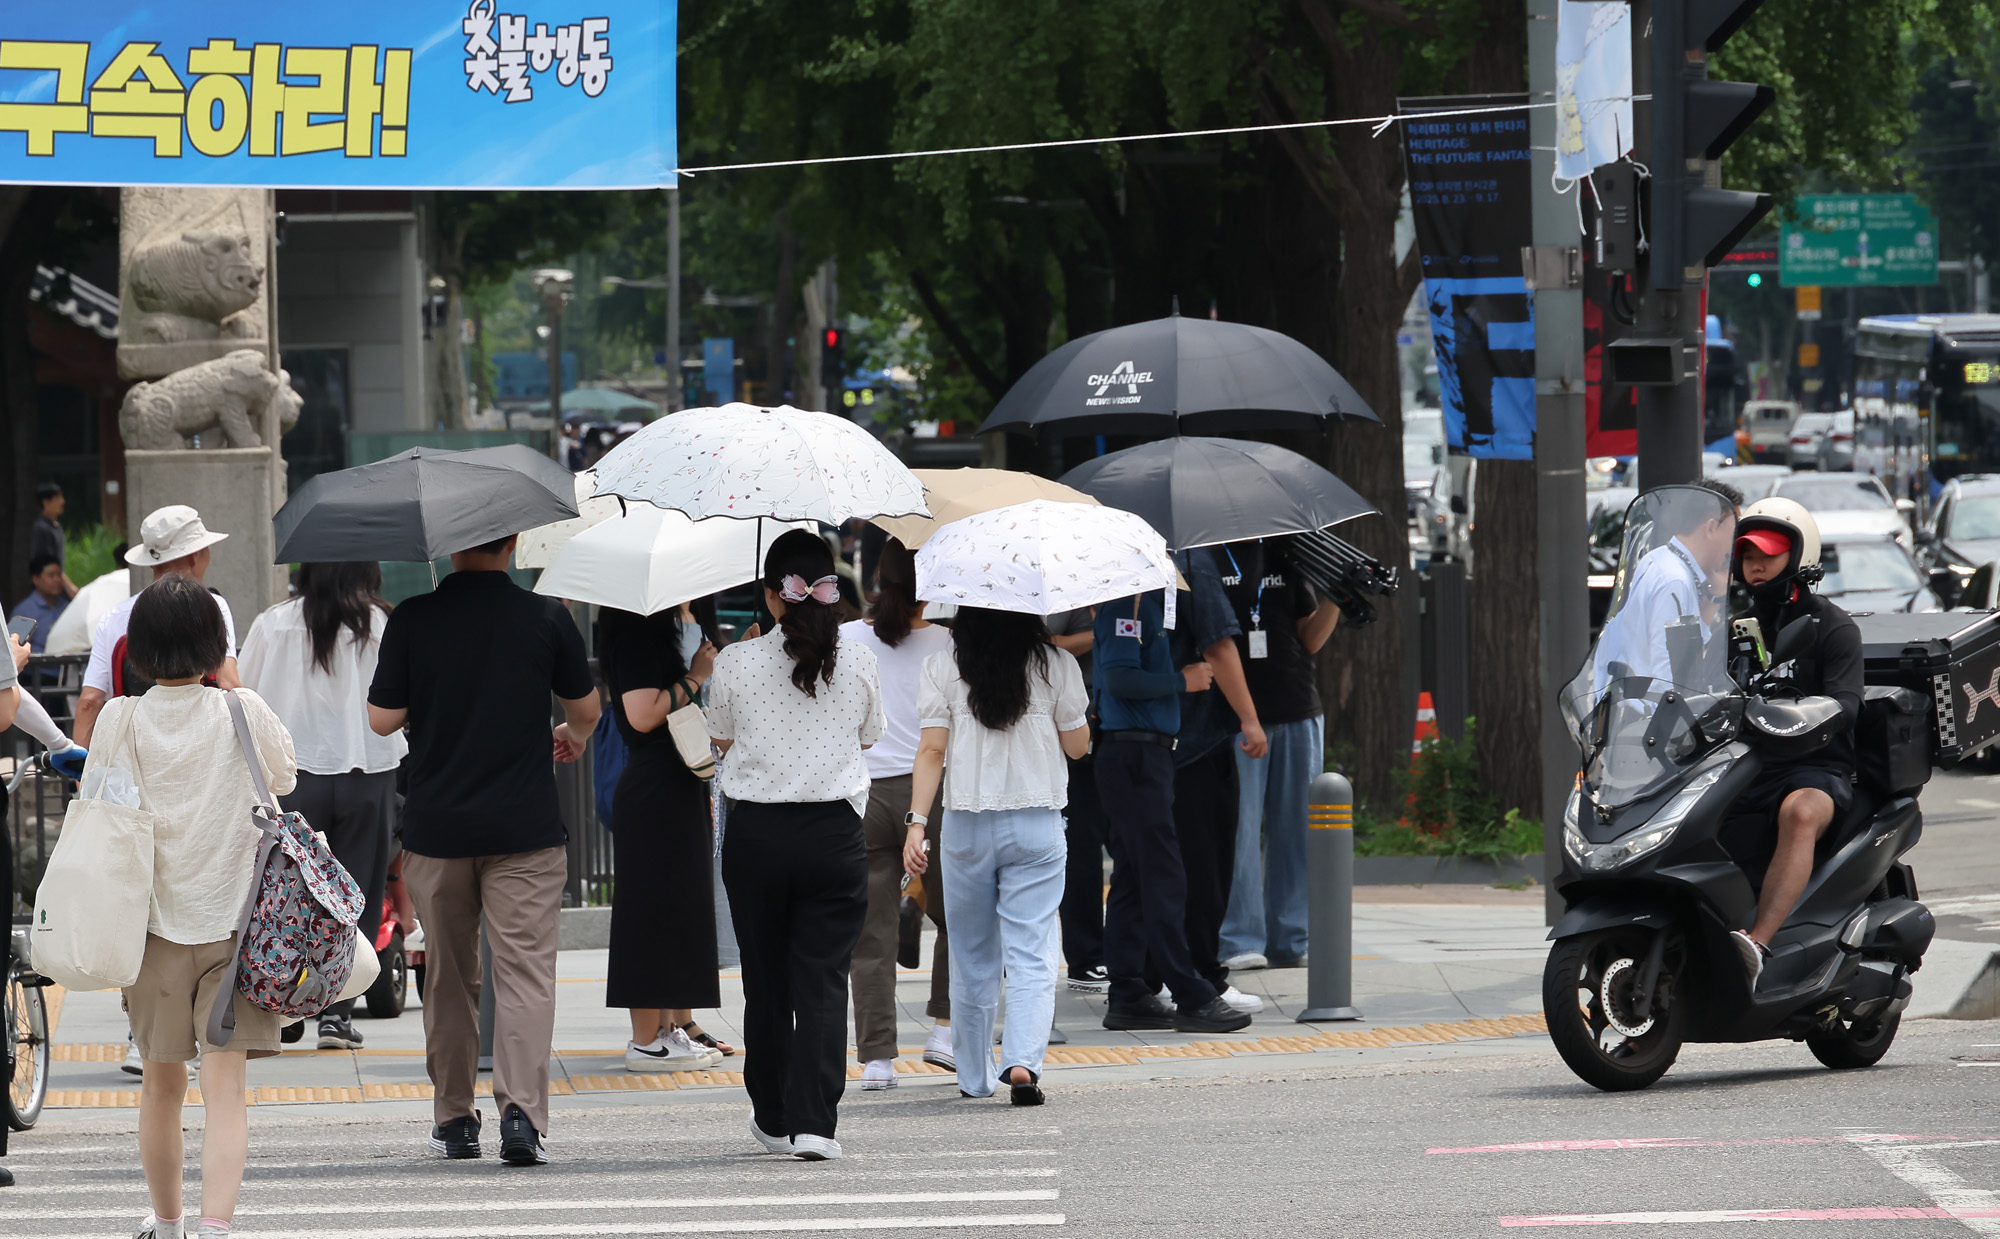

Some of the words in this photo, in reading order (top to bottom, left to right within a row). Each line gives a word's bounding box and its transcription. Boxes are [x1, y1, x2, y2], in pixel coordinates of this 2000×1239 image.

[463, 0, 613, 103] 촛불행동
[0, 38, 413, 158] 구속하라!
[1455, 121, 1467, 135] 더
[1411, 153, 1433, 164] THE
[1435, 151, 1482, 164] FUTURE
[1087, 372, 1154, 385] CHANNEL
